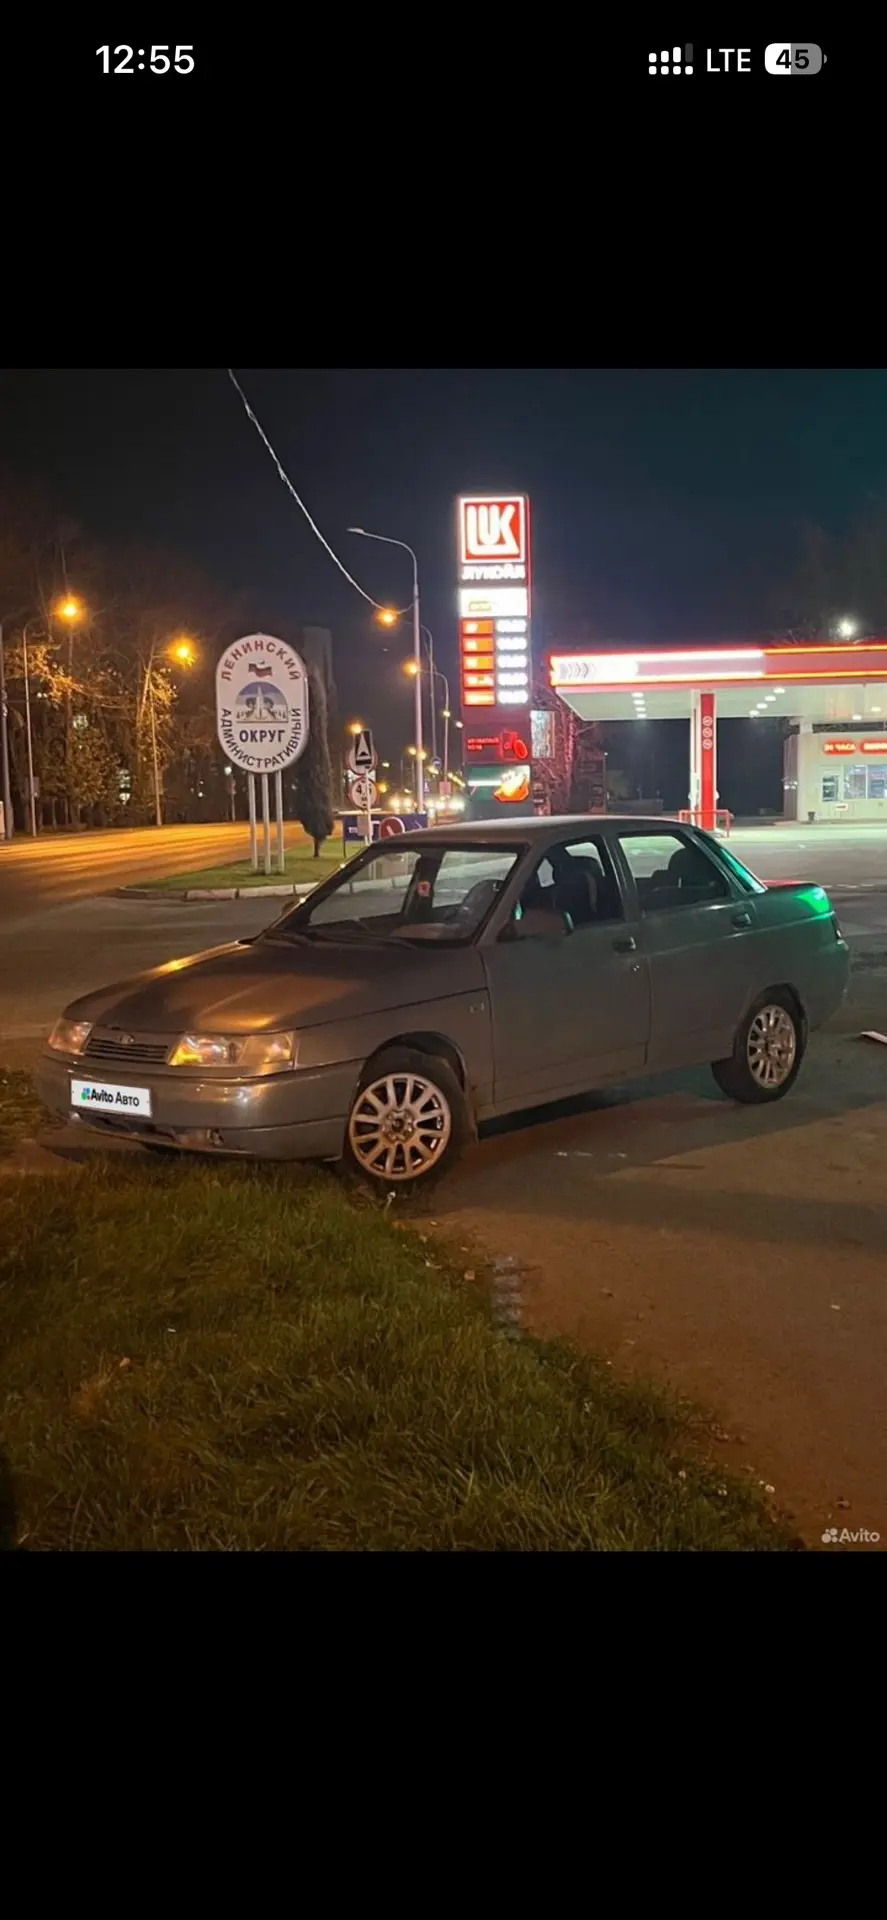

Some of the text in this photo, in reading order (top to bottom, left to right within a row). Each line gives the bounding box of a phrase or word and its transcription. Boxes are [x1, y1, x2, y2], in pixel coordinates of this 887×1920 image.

[220, 640, 301, 681] ЛЕНИНСКИЙ
[220, 708, 301, 768] АДМИНИСТРАТИВНЫЙ
[239, 730, 286, 743] ОКРУГ
